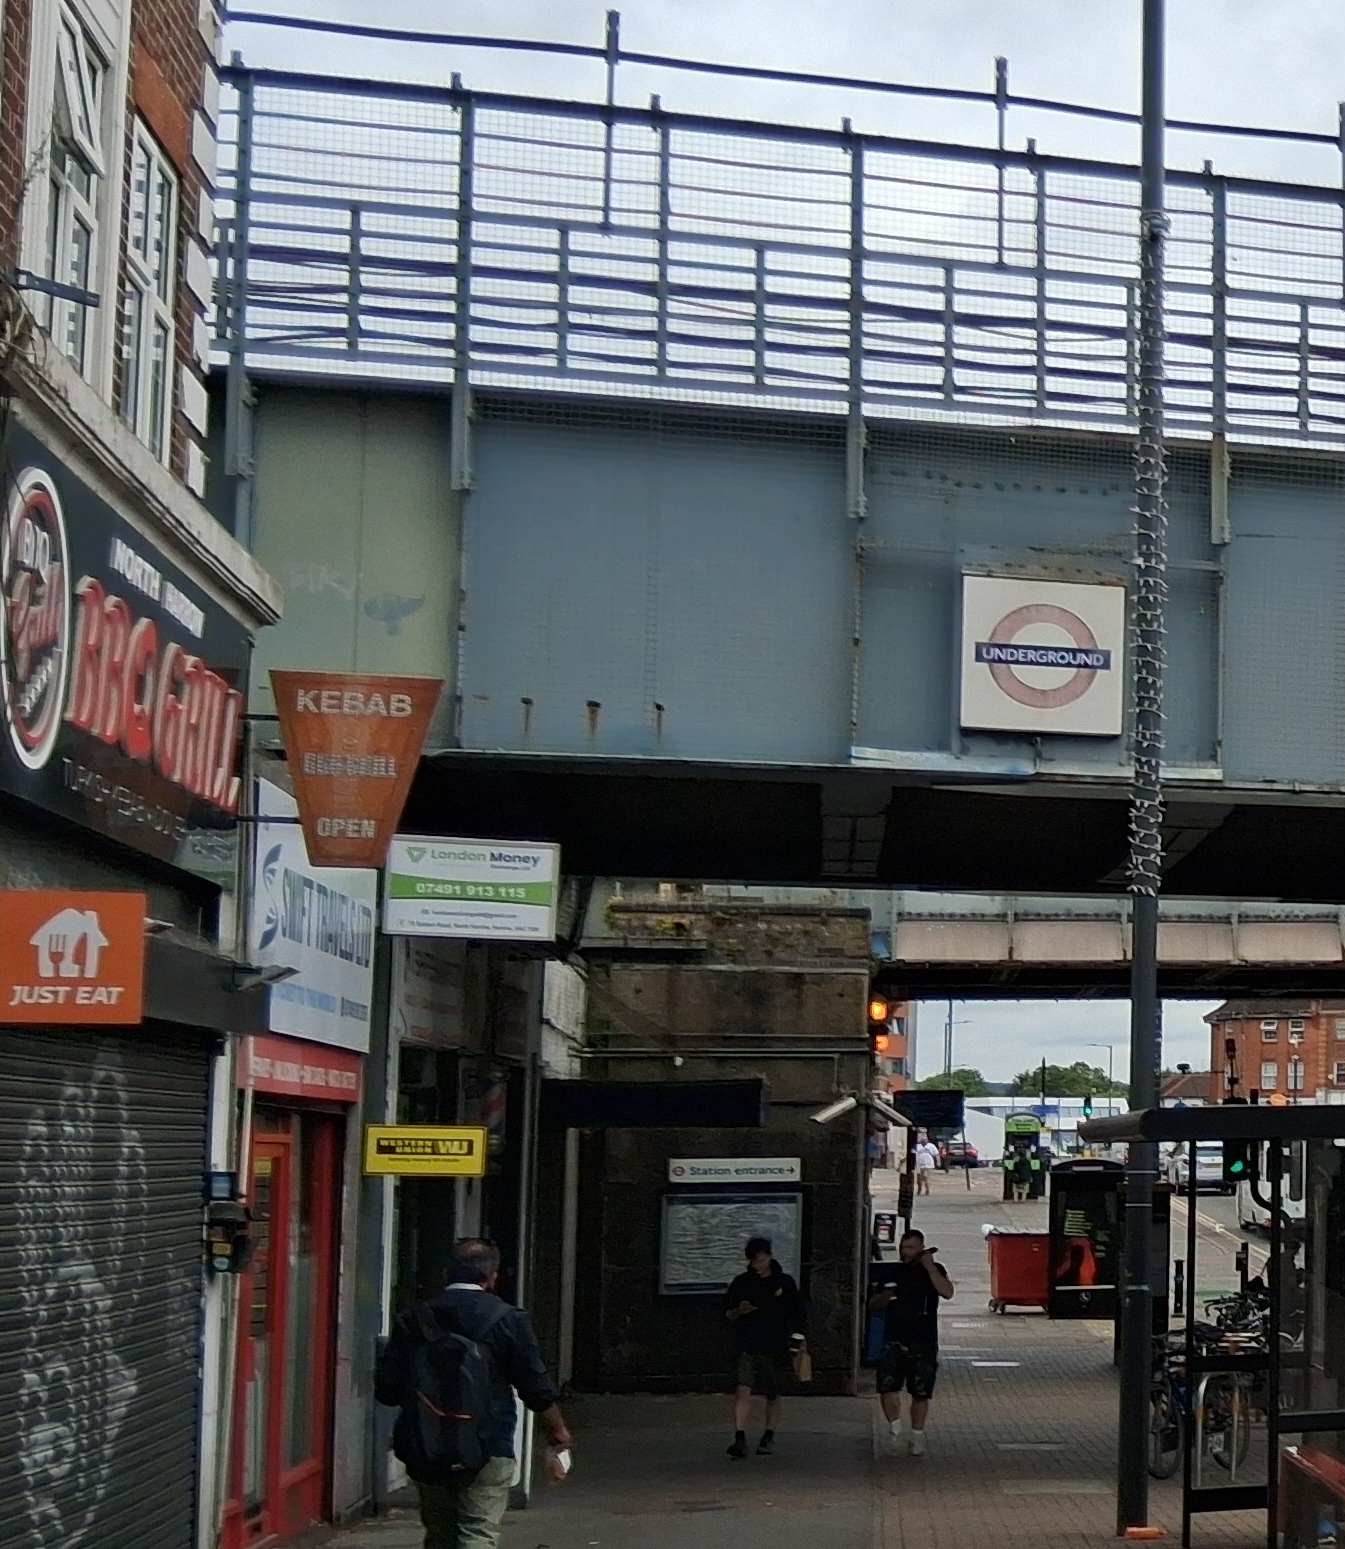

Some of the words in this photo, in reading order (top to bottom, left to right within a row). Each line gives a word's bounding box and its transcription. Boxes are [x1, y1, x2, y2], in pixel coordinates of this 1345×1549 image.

[982, 647, 1104, 666] UNDERGROUND
[297, 689, 412, 718] KEBAB
[317, 817, 376, 838] OPEN
[430, 849, 487, 862] London
[489, 851, 541, 867] Money
[416, 883, 461, 895] 07491
[465, 884, 494, 897] 913
[500, 886, 526, 898] 115
[281, 867, 314, 946] SWIFT
[9, 985, 72, 1006] JUST
[75, 986, 125, 1005] EAT
[380, 1139, 432, 1147] WESTERN
[437, 1140, 469, 1154] WU
[690, 1167, 731, 1176] Station
[735, 1167, 786, 1175] entrance
